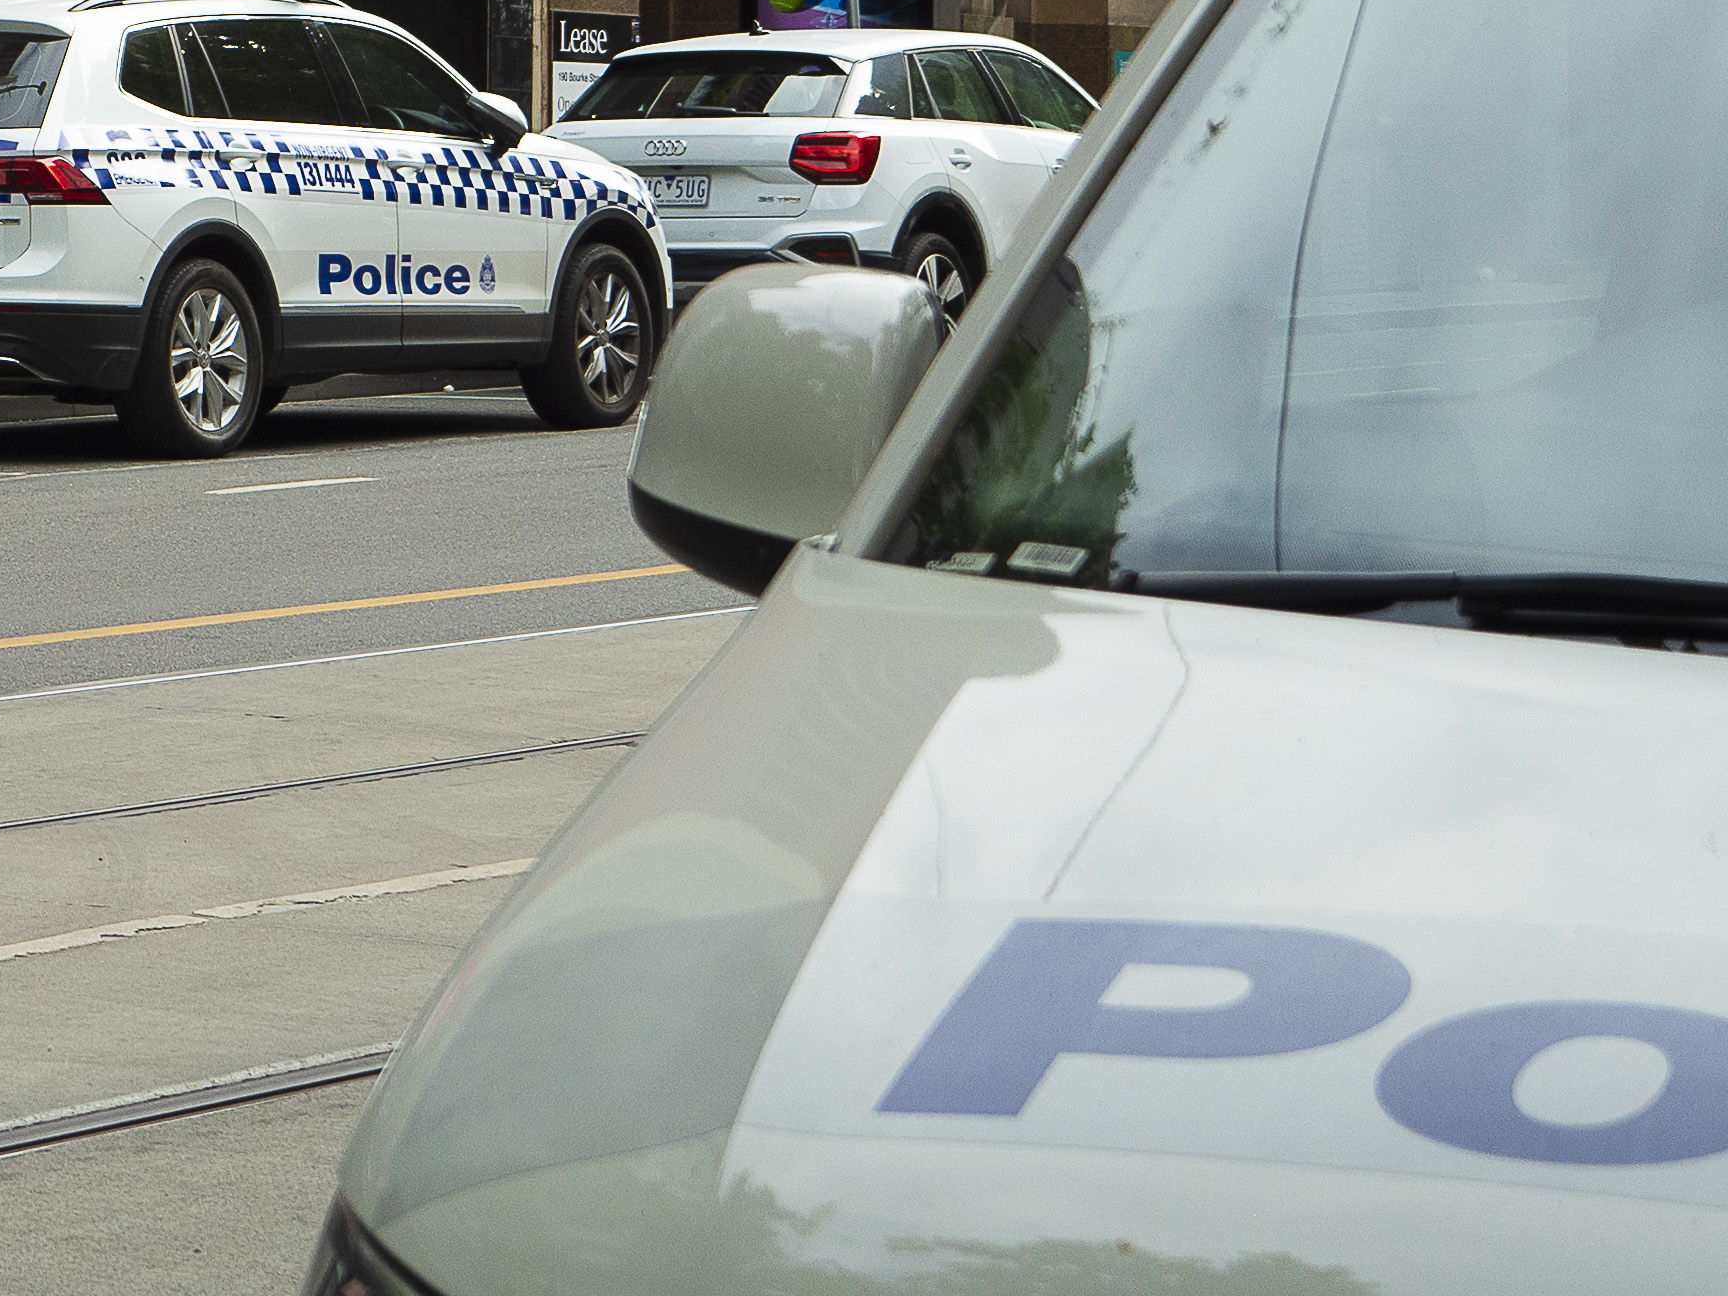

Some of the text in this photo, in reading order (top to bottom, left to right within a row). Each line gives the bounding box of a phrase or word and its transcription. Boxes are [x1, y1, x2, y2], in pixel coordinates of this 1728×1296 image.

[560, 20, 608, 54] Lease
[558, 72, 588, 83] 190 Bourke
[318, 254, 471, 296] Police
